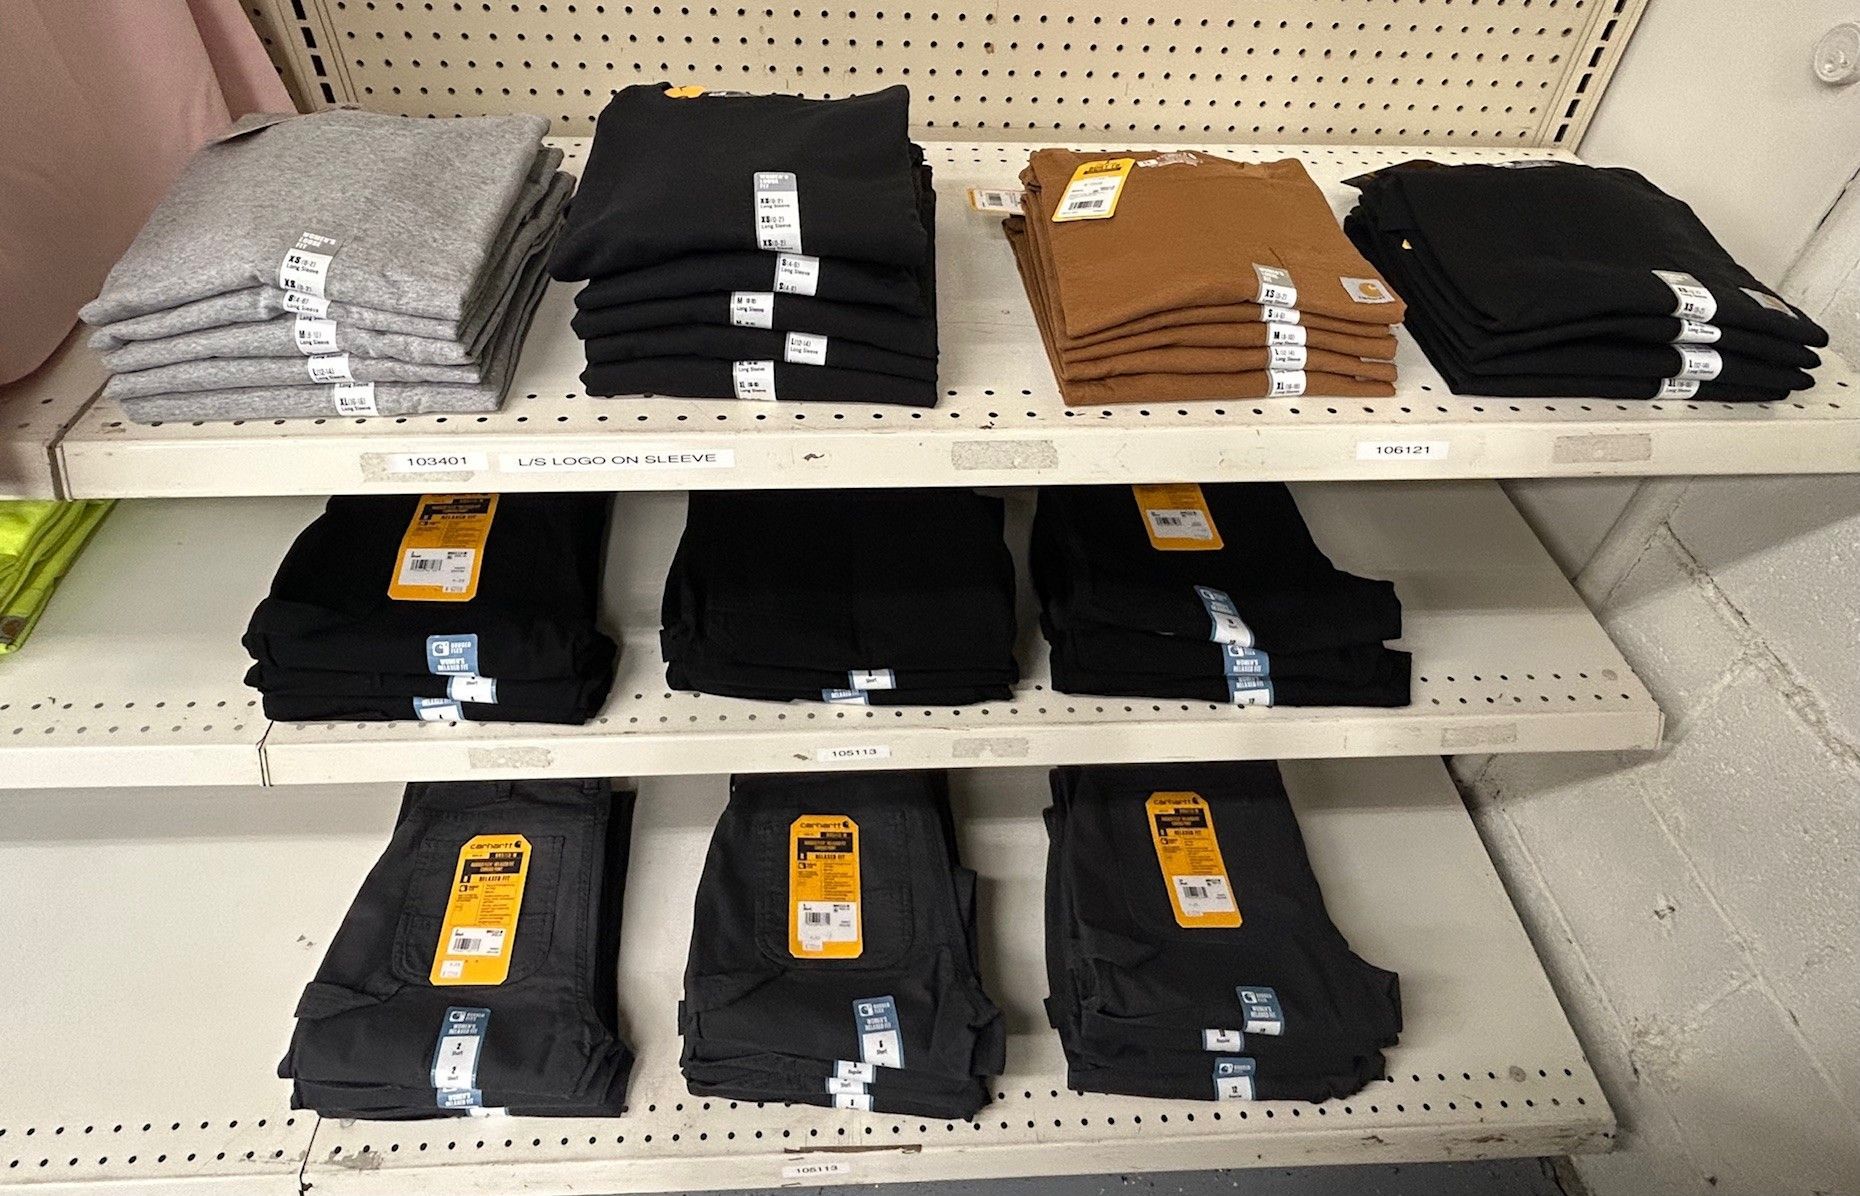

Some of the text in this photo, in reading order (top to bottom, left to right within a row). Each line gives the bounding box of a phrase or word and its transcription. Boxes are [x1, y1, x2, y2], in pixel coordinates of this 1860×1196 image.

[289, 255, 301, 264] XS
[287, 263, 319, 275] Long Sleeve
[284, 278, 296, 288] XS
[288, 294, 294, 302] S
[1265, 289, 1275, 299] XS
[287, 303, 319, 313] Long Sleeve
[1684, 303, 1694, 312] XS
[1268, 309, 1273, 318] S
[299, 330, 305, 339] M
[1273, 331, 1280, 340] M
[1688, 327, 1700, 335] Long
[313, 368, 317, 376] L
[1276, 382, 1284, 390] XL
[340, 398, 348, 406] XL
[1376, 446, 1430, 455] 106121
[407, 456, 468, 467] 103401
[518, 453, 717, 467] L/S LOGO ON SLEEVE
[832, 748, 877, 757] 105113
[457, 1042, 461, 1050] 2
[797, 1165, 838, 1173] 105113
